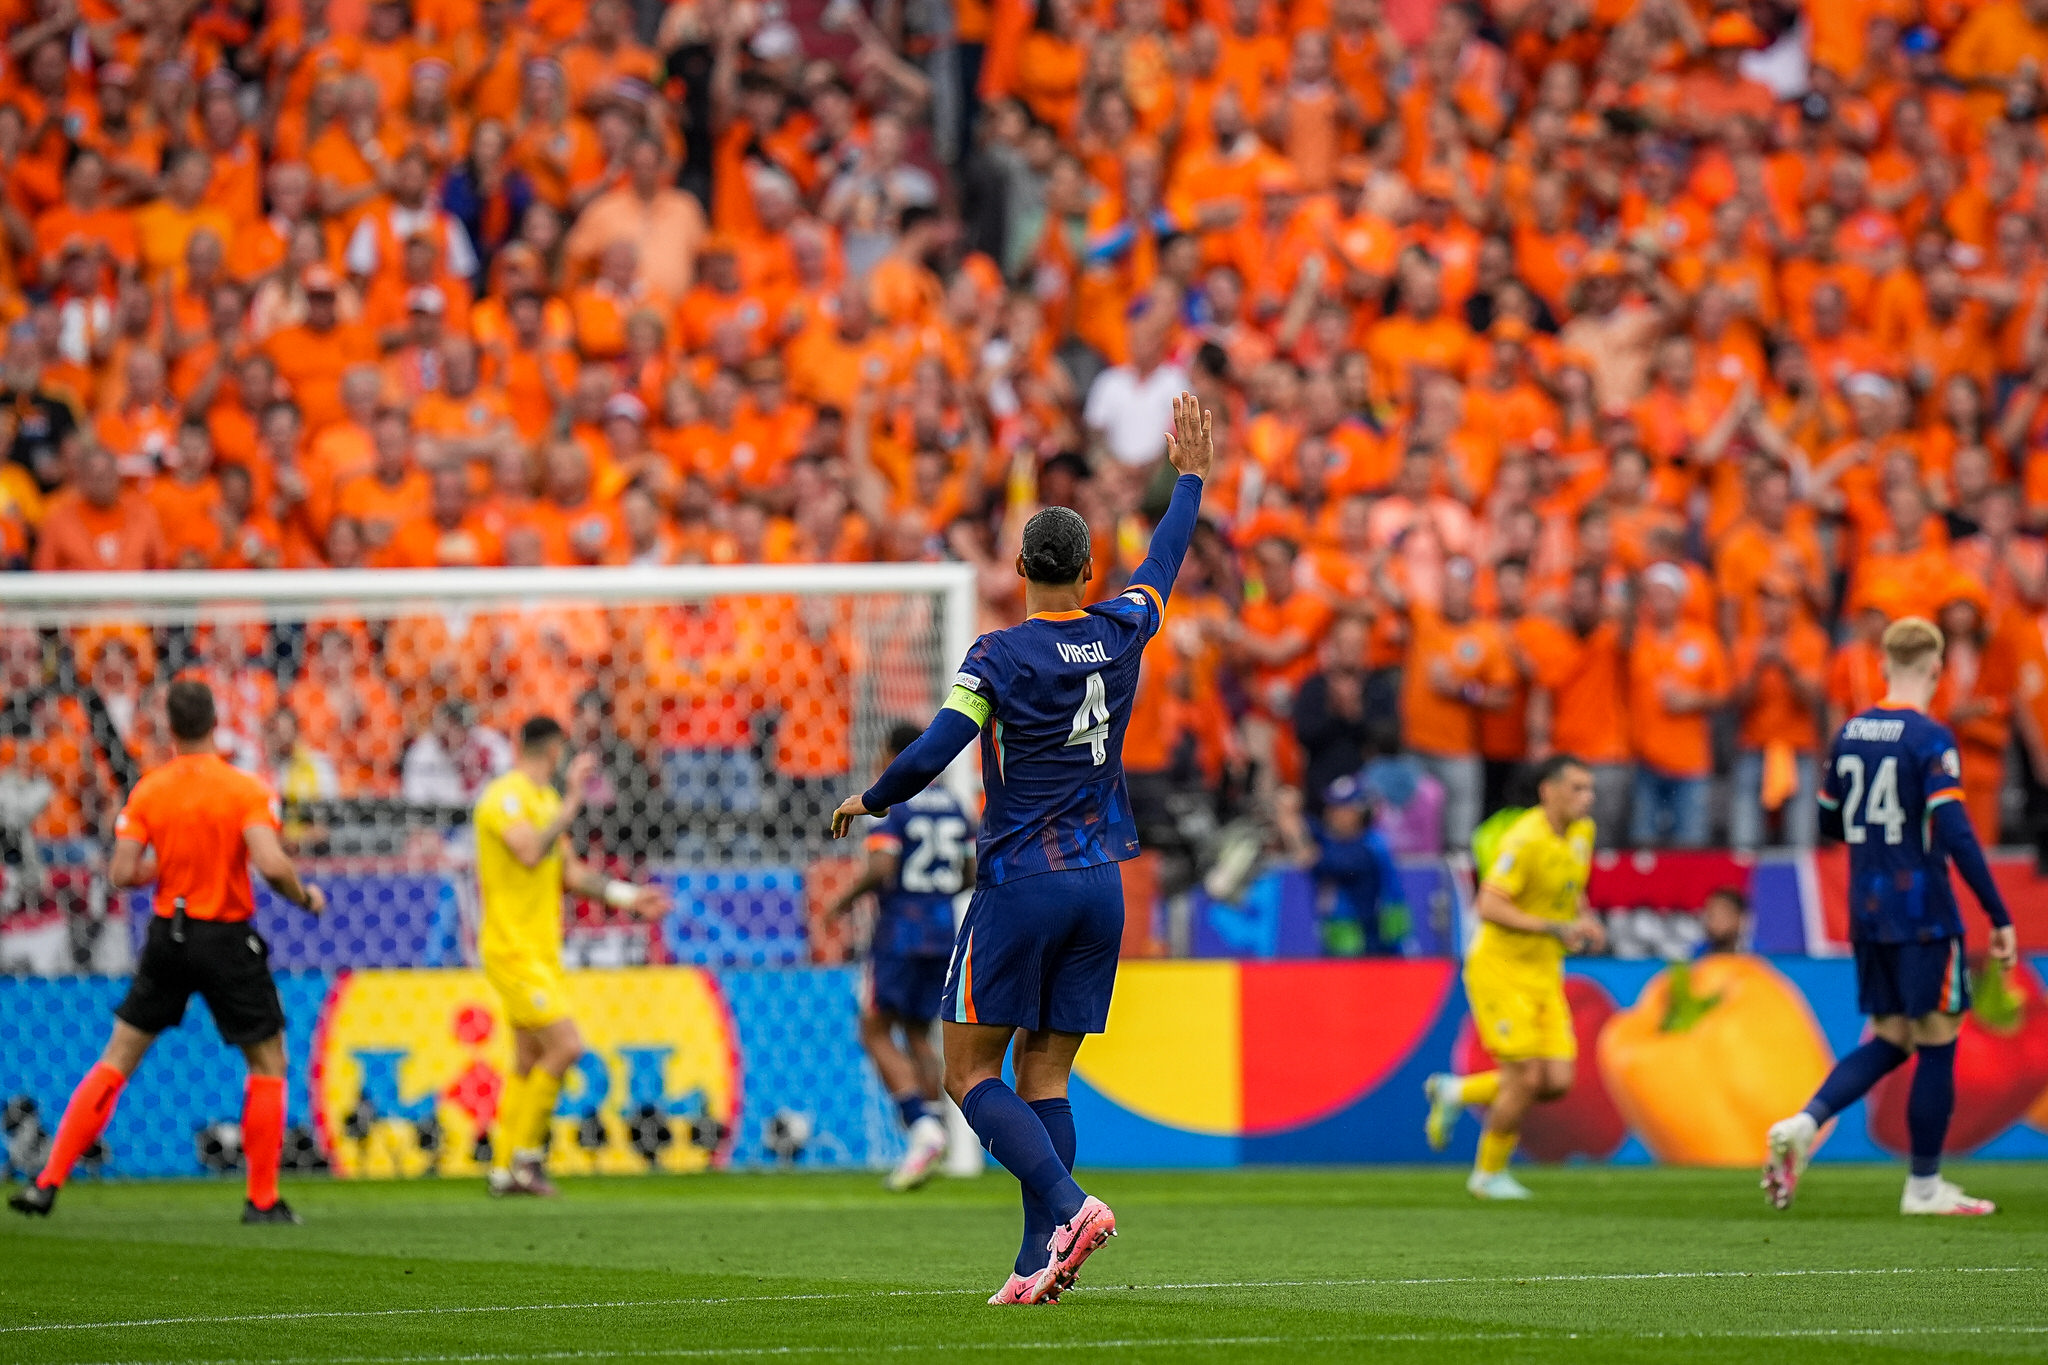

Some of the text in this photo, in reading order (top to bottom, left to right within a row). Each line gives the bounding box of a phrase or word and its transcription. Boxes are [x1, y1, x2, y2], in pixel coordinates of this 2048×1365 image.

[1056, 641, 1112, 662] VIRGIL
[1063, 671, 1110, 766] 4
[1836, 754, 1906, 844] 24
[902, 815, 966, 893] 25
